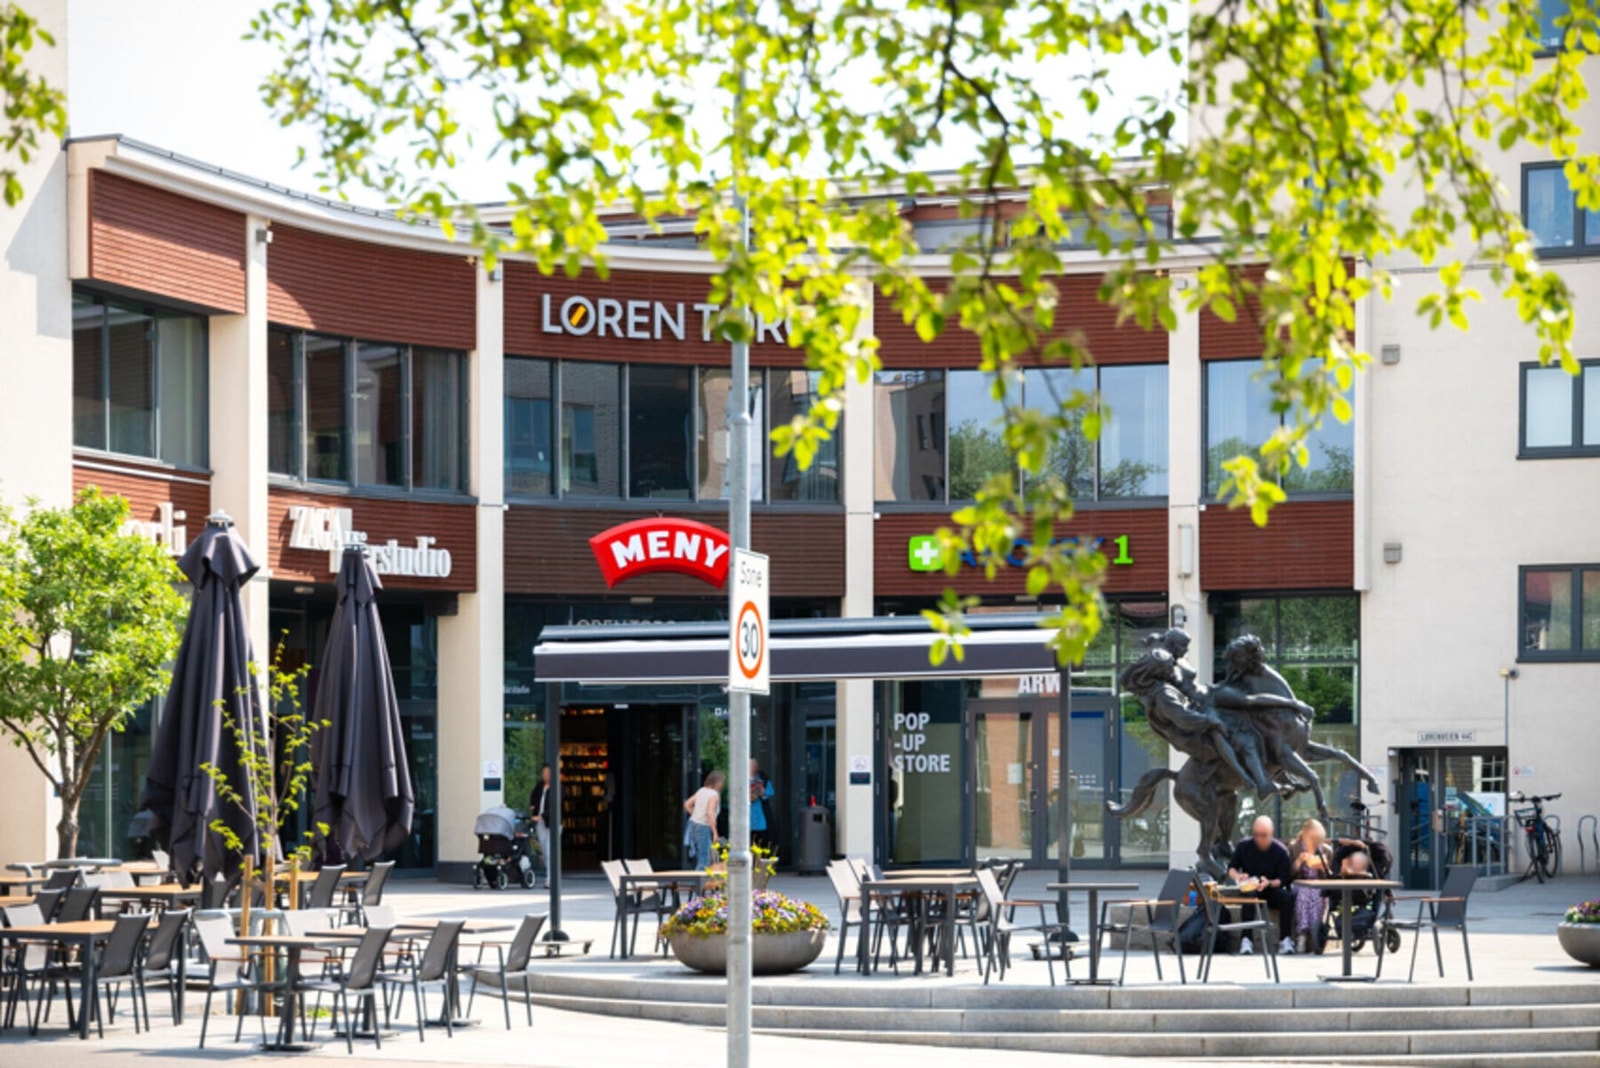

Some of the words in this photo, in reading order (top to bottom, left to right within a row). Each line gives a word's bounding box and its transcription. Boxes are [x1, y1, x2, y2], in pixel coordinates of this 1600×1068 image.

[610, 530, 729, 568] MENY
[741, 621, 759, 659] 30
[893, 712, 930, 731] POP
[893, 754, 951, 773] STORE
